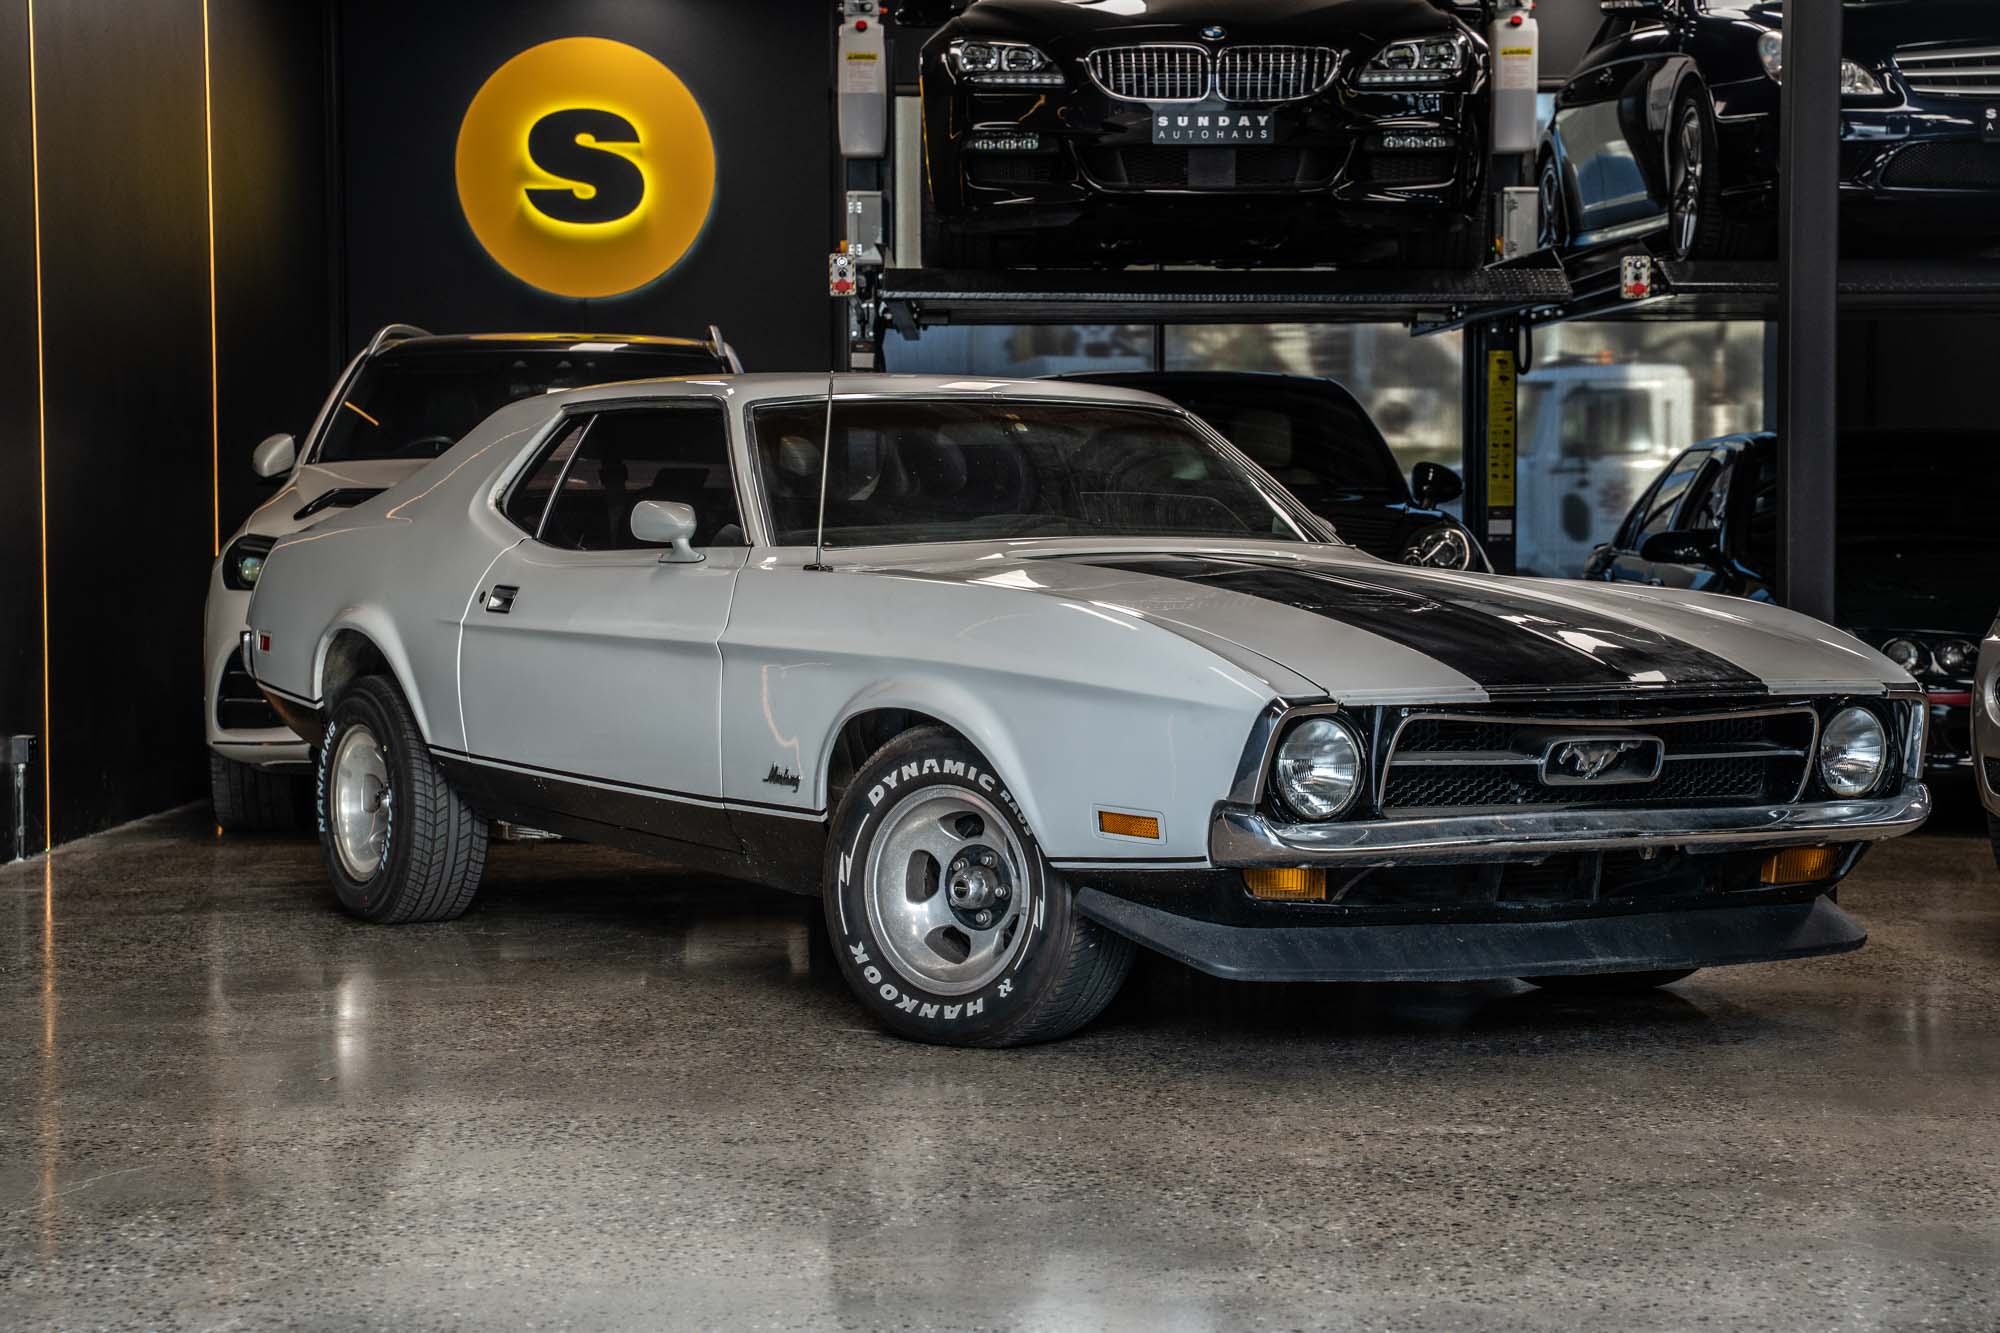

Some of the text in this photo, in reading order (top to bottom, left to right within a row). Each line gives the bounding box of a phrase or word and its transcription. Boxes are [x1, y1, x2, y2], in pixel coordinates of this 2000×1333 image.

[1157, 115, 1269, 127] SUNDAY
[1158, 129, 1268, 139] AUTOHAUS
[524, 108, 645, 225] S
[316, 720, 336, 832] NANKANG
[868, 758, 996, 807] DYNAMIC
[849, 941, 984, 1020] HANKOOK
